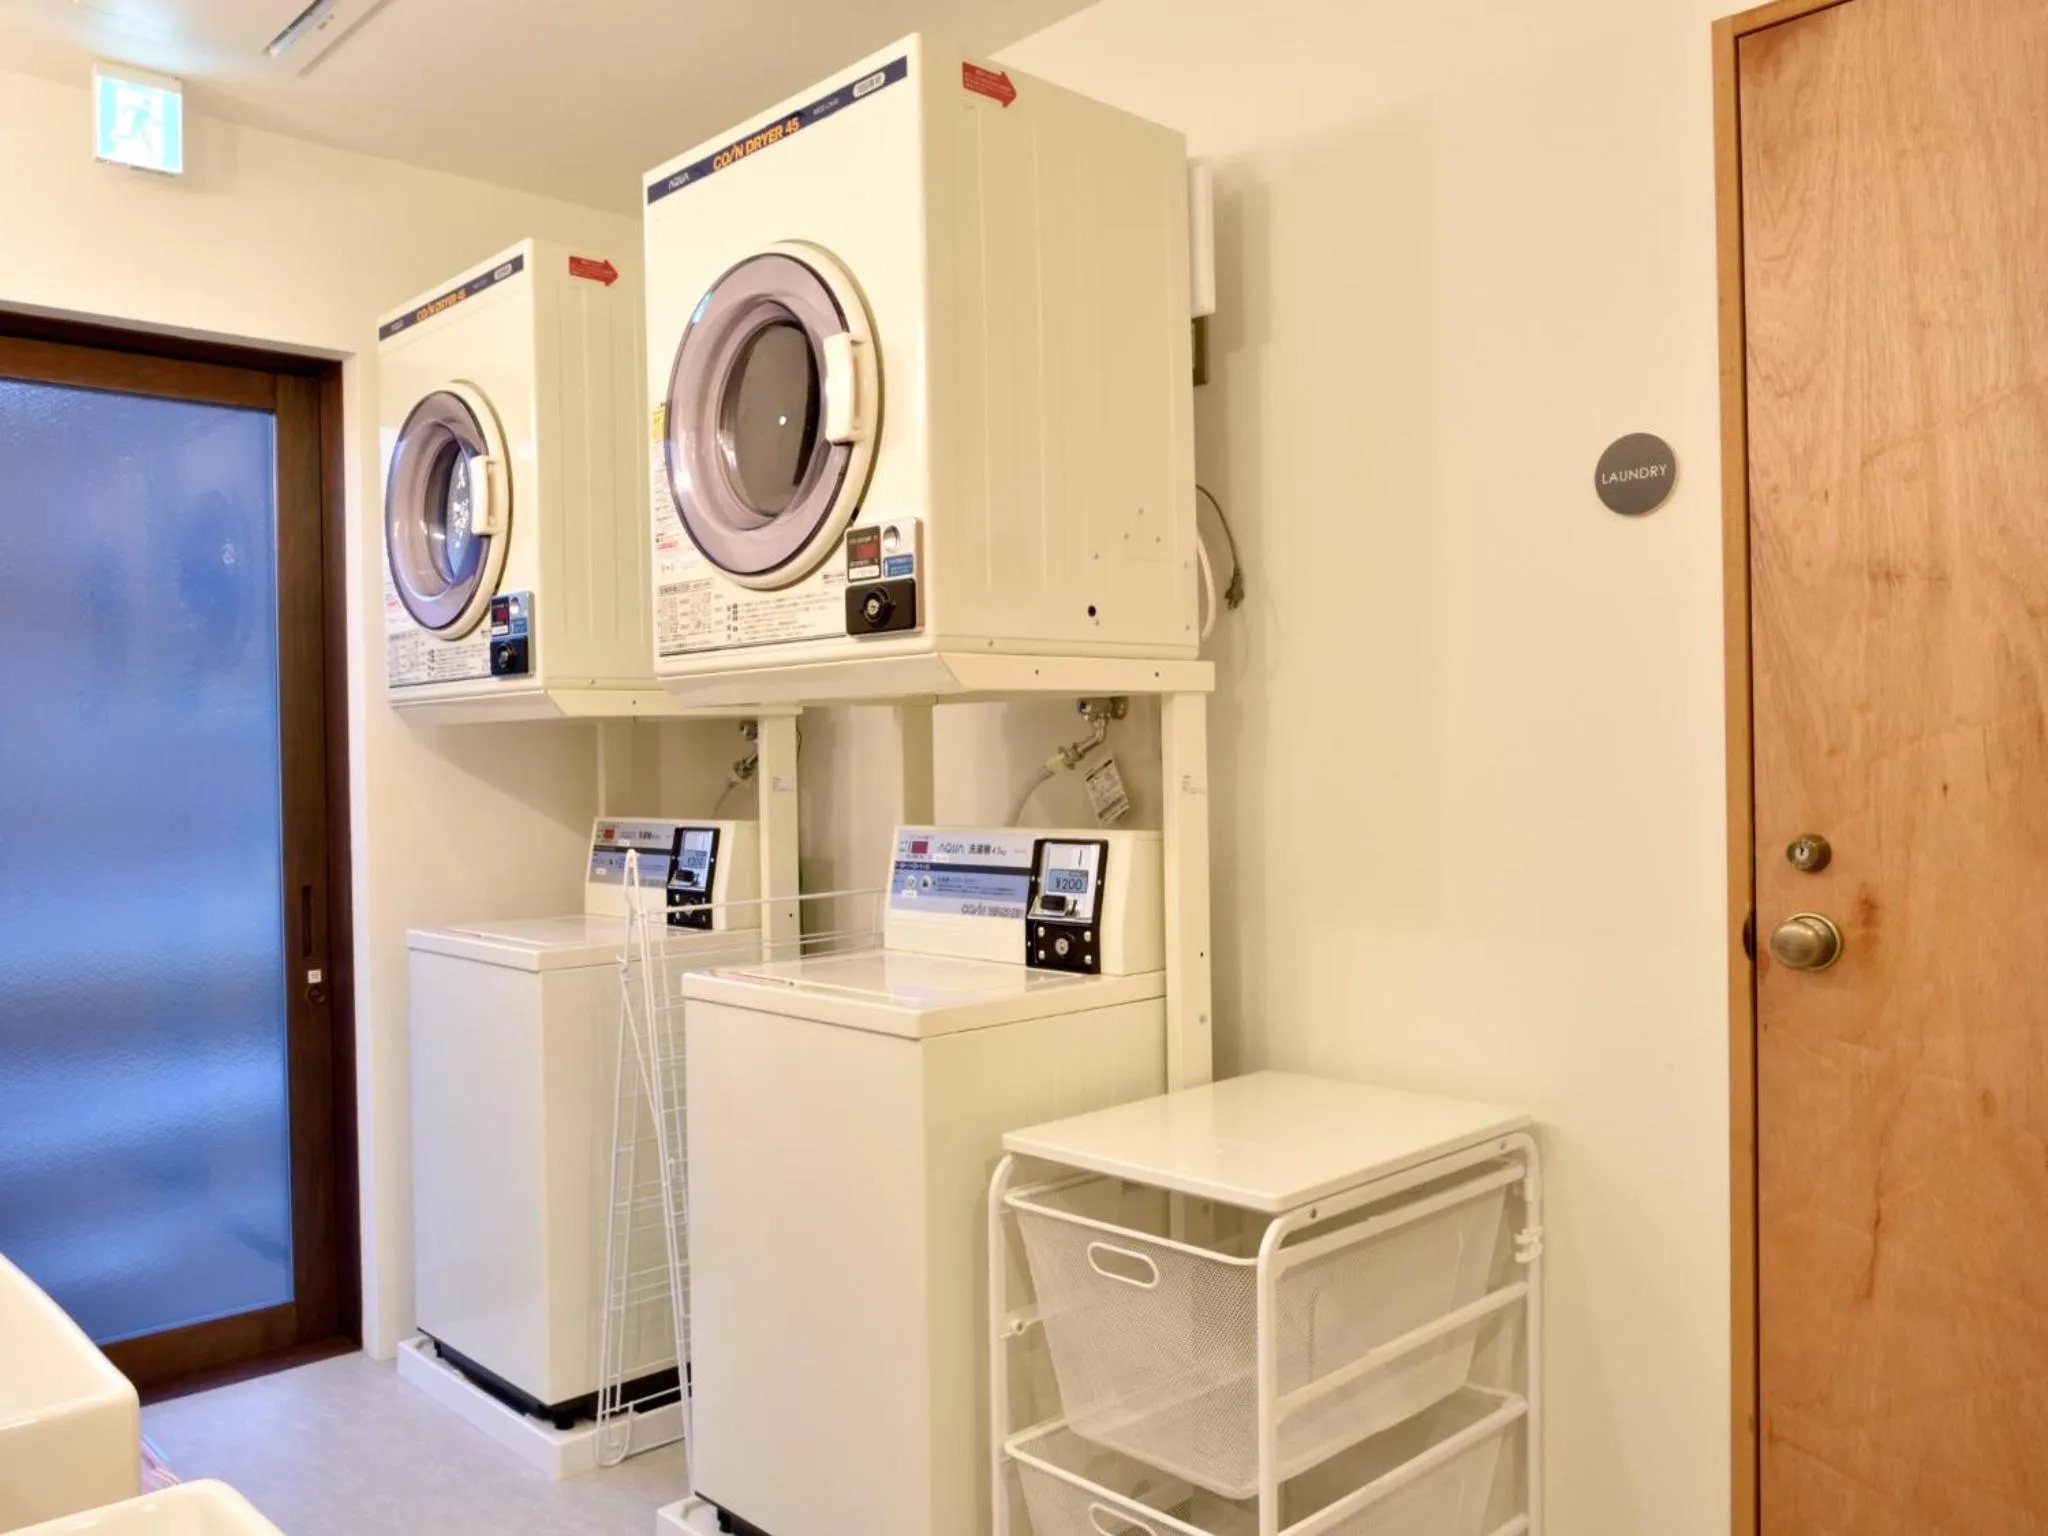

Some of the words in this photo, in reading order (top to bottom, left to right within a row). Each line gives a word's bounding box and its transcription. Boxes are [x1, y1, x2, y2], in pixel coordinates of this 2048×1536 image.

[745, 124, 783, 154] DRYER
[785, 115, 800, 134] 45
[1601, 463, 1668, 485] LAUNDRY
[937, 842, 965, 855] AQUA
[1055, 876, 1084, 891] ¥200
